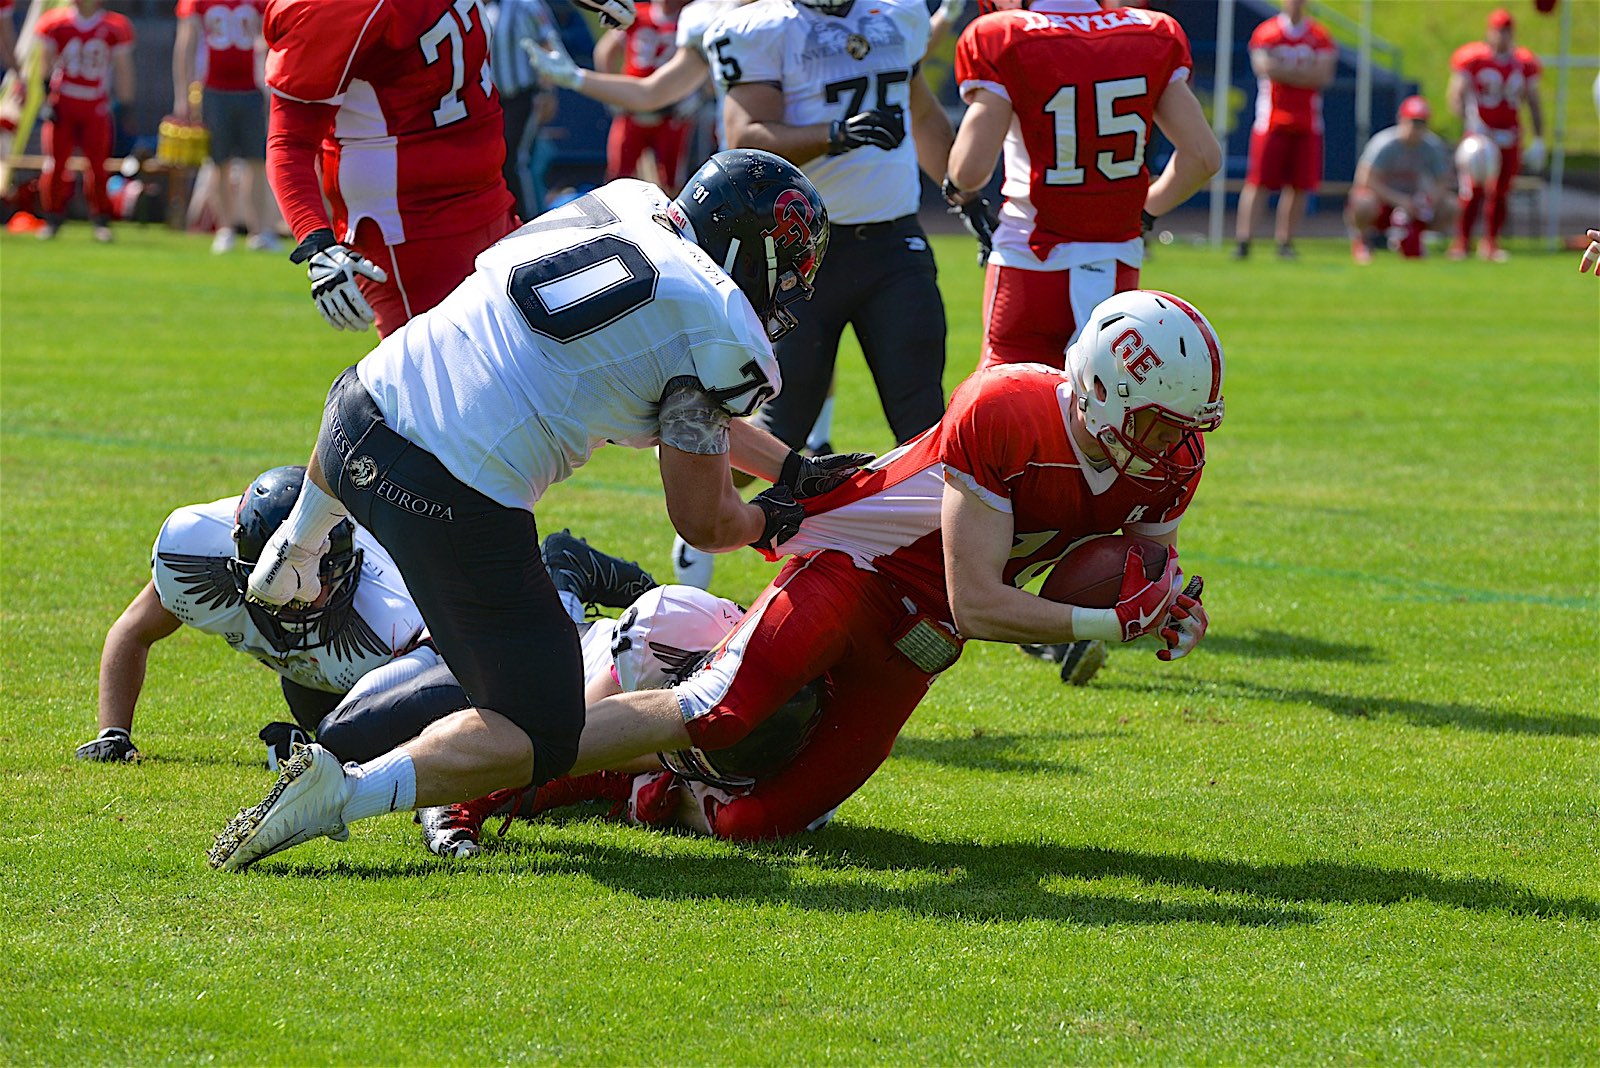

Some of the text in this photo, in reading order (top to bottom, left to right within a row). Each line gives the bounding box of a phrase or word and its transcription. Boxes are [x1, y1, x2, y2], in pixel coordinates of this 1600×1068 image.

[1014, 10, 1152, 32] DEVILS
[1043, 76, 1148, 186] 15
[492, 191, 661, 345] 70
[1110, 327, 1165, 385] GE
[376, 480, 454, 521] EUROPA
